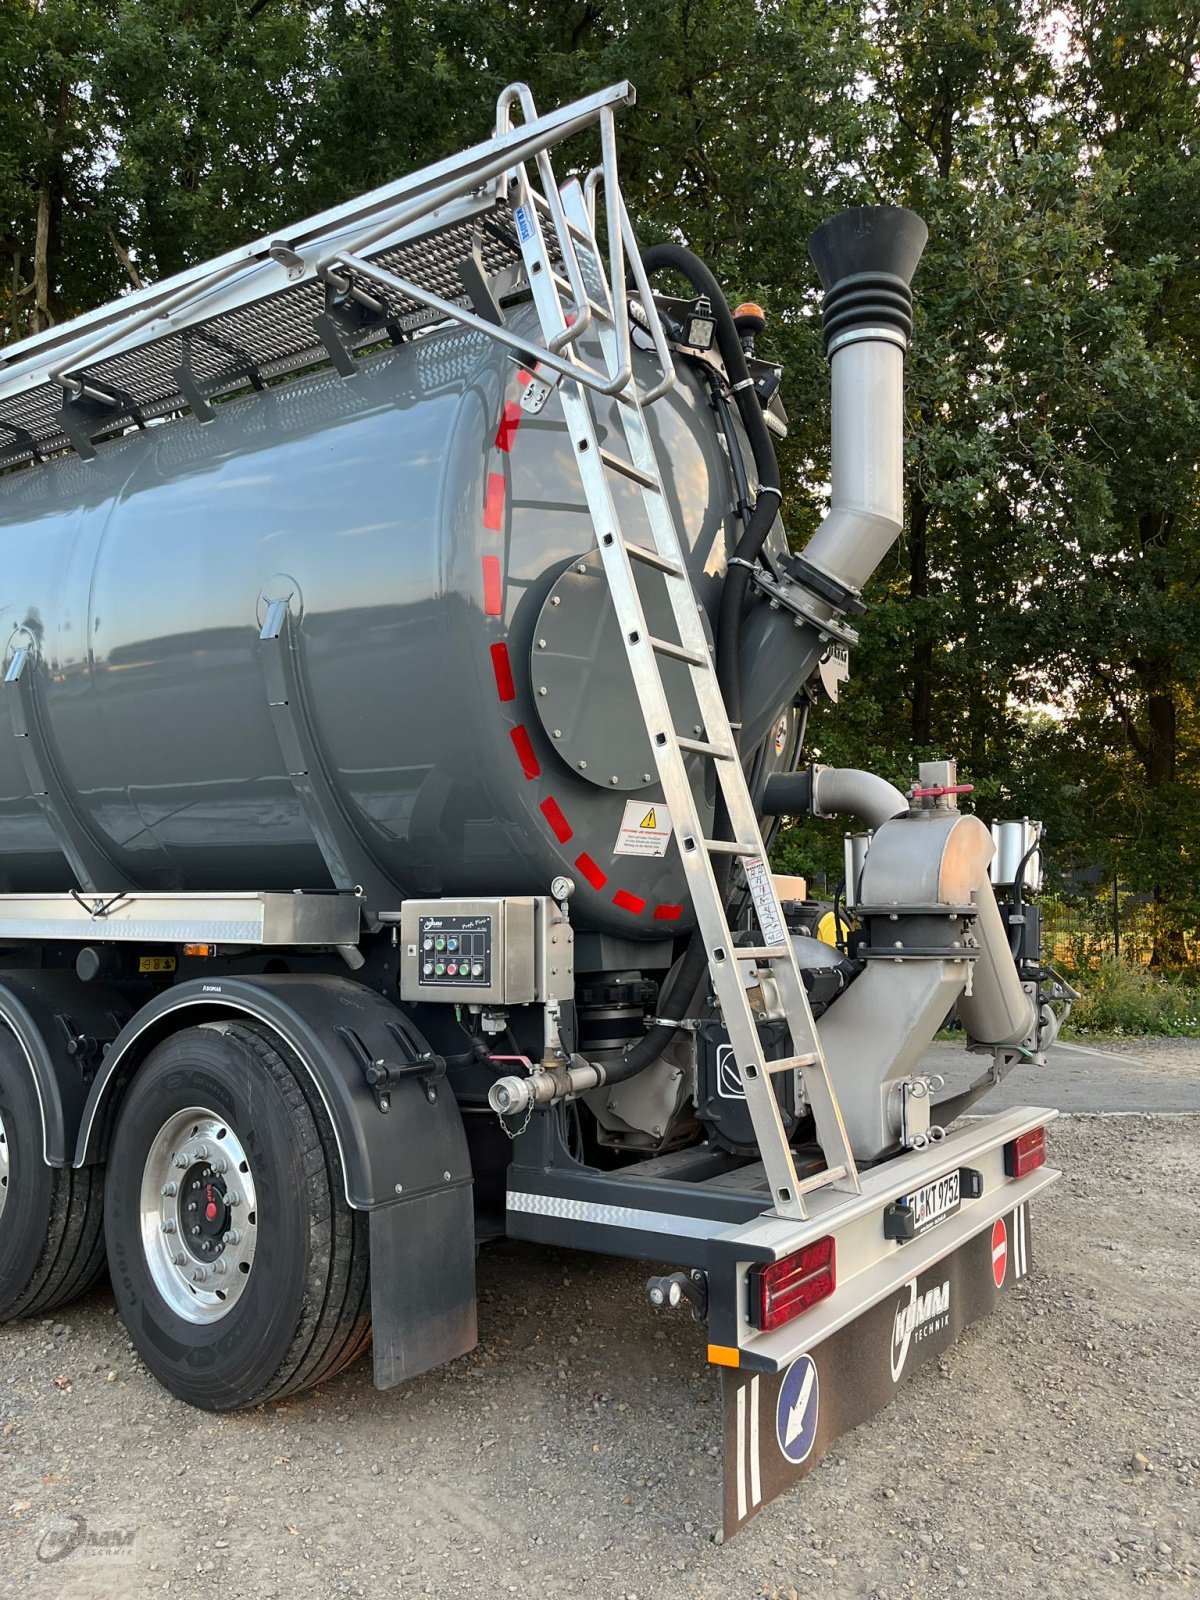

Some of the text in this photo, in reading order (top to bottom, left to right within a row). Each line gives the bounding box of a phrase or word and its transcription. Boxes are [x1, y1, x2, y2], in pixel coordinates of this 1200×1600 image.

[516, 207, 529, 240] KRAUSE
[925, 1184, 937, 1218] KT
[938, 1174, 958, 1210] 9752
[914, 1314, 949, 1344] TECHNIK
